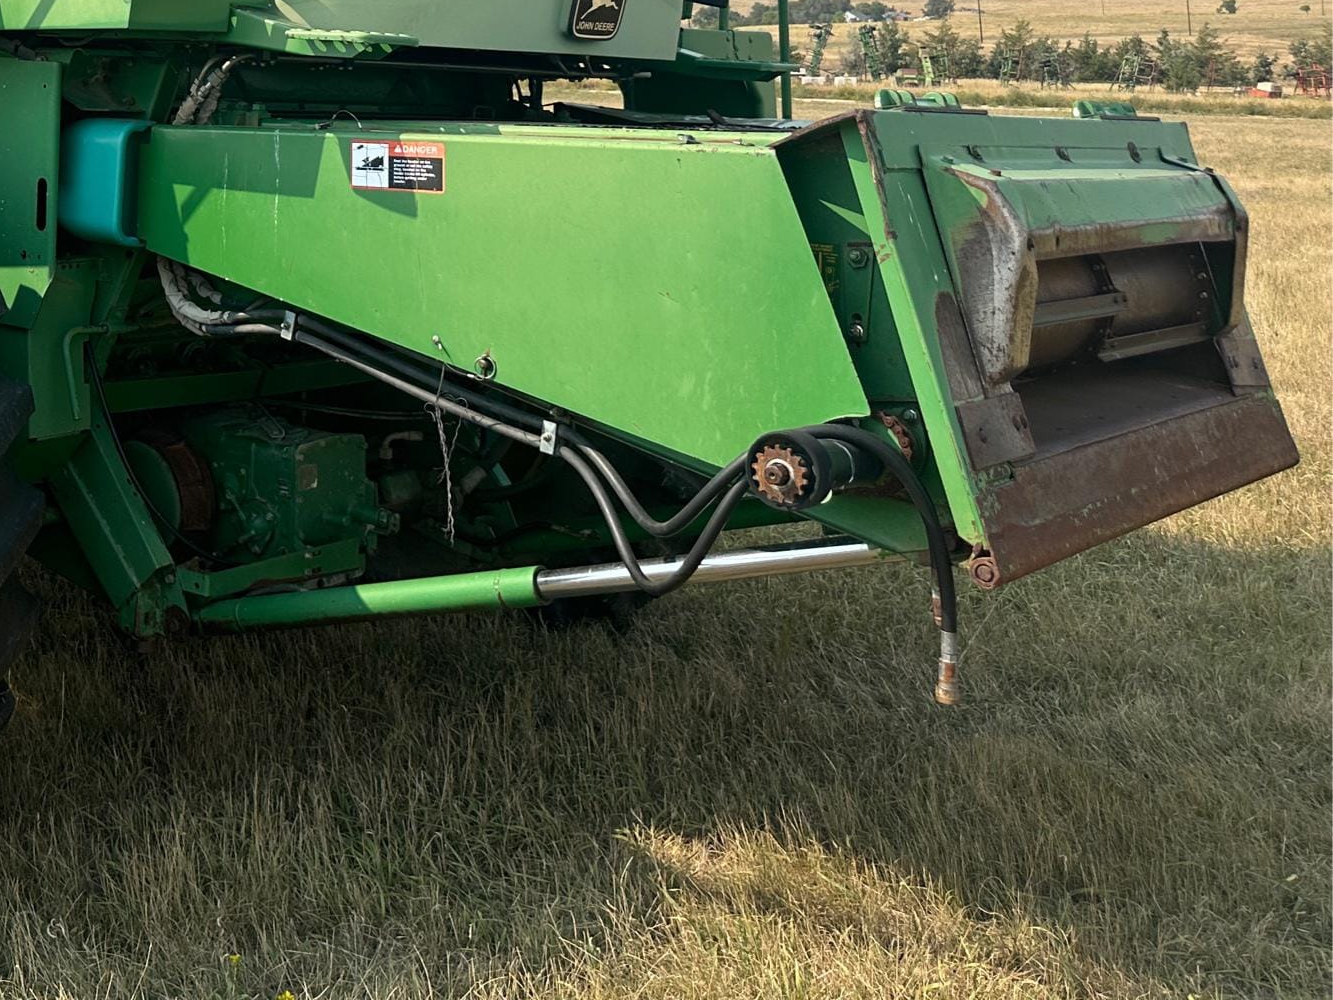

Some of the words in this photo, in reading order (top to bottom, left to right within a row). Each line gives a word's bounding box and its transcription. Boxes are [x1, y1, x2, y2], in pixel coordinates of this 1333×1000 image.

[576, 20, 594, 31] JOHN
[594, 22, 616, 32] DEERE
[402, 144, 438, 154] DANGER
